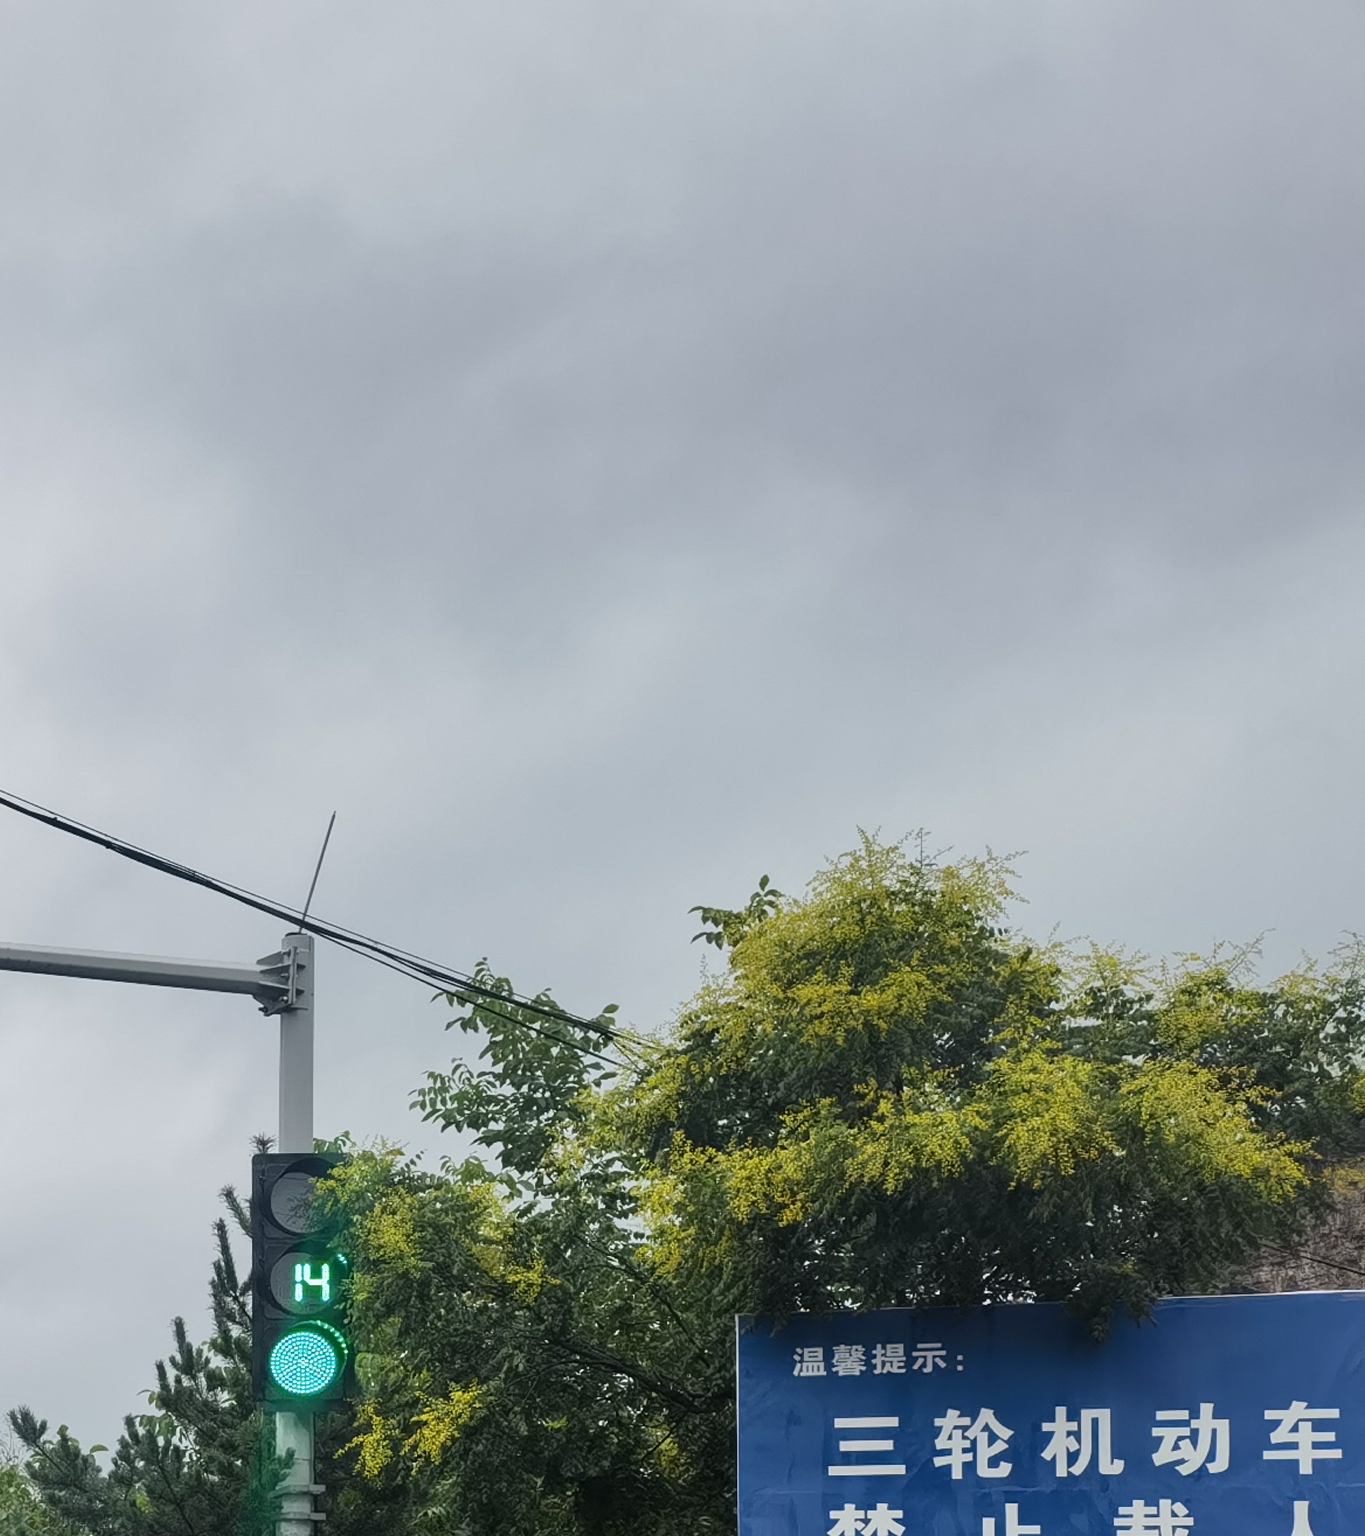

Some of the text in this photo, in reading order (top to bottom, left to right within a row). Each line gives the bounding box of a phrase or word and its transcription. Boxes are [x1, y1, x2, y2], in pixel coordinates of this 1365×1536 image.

[294, 1263, 330, 1302] 14
[827, 1401, 1344, 1480] 三轮机动车
